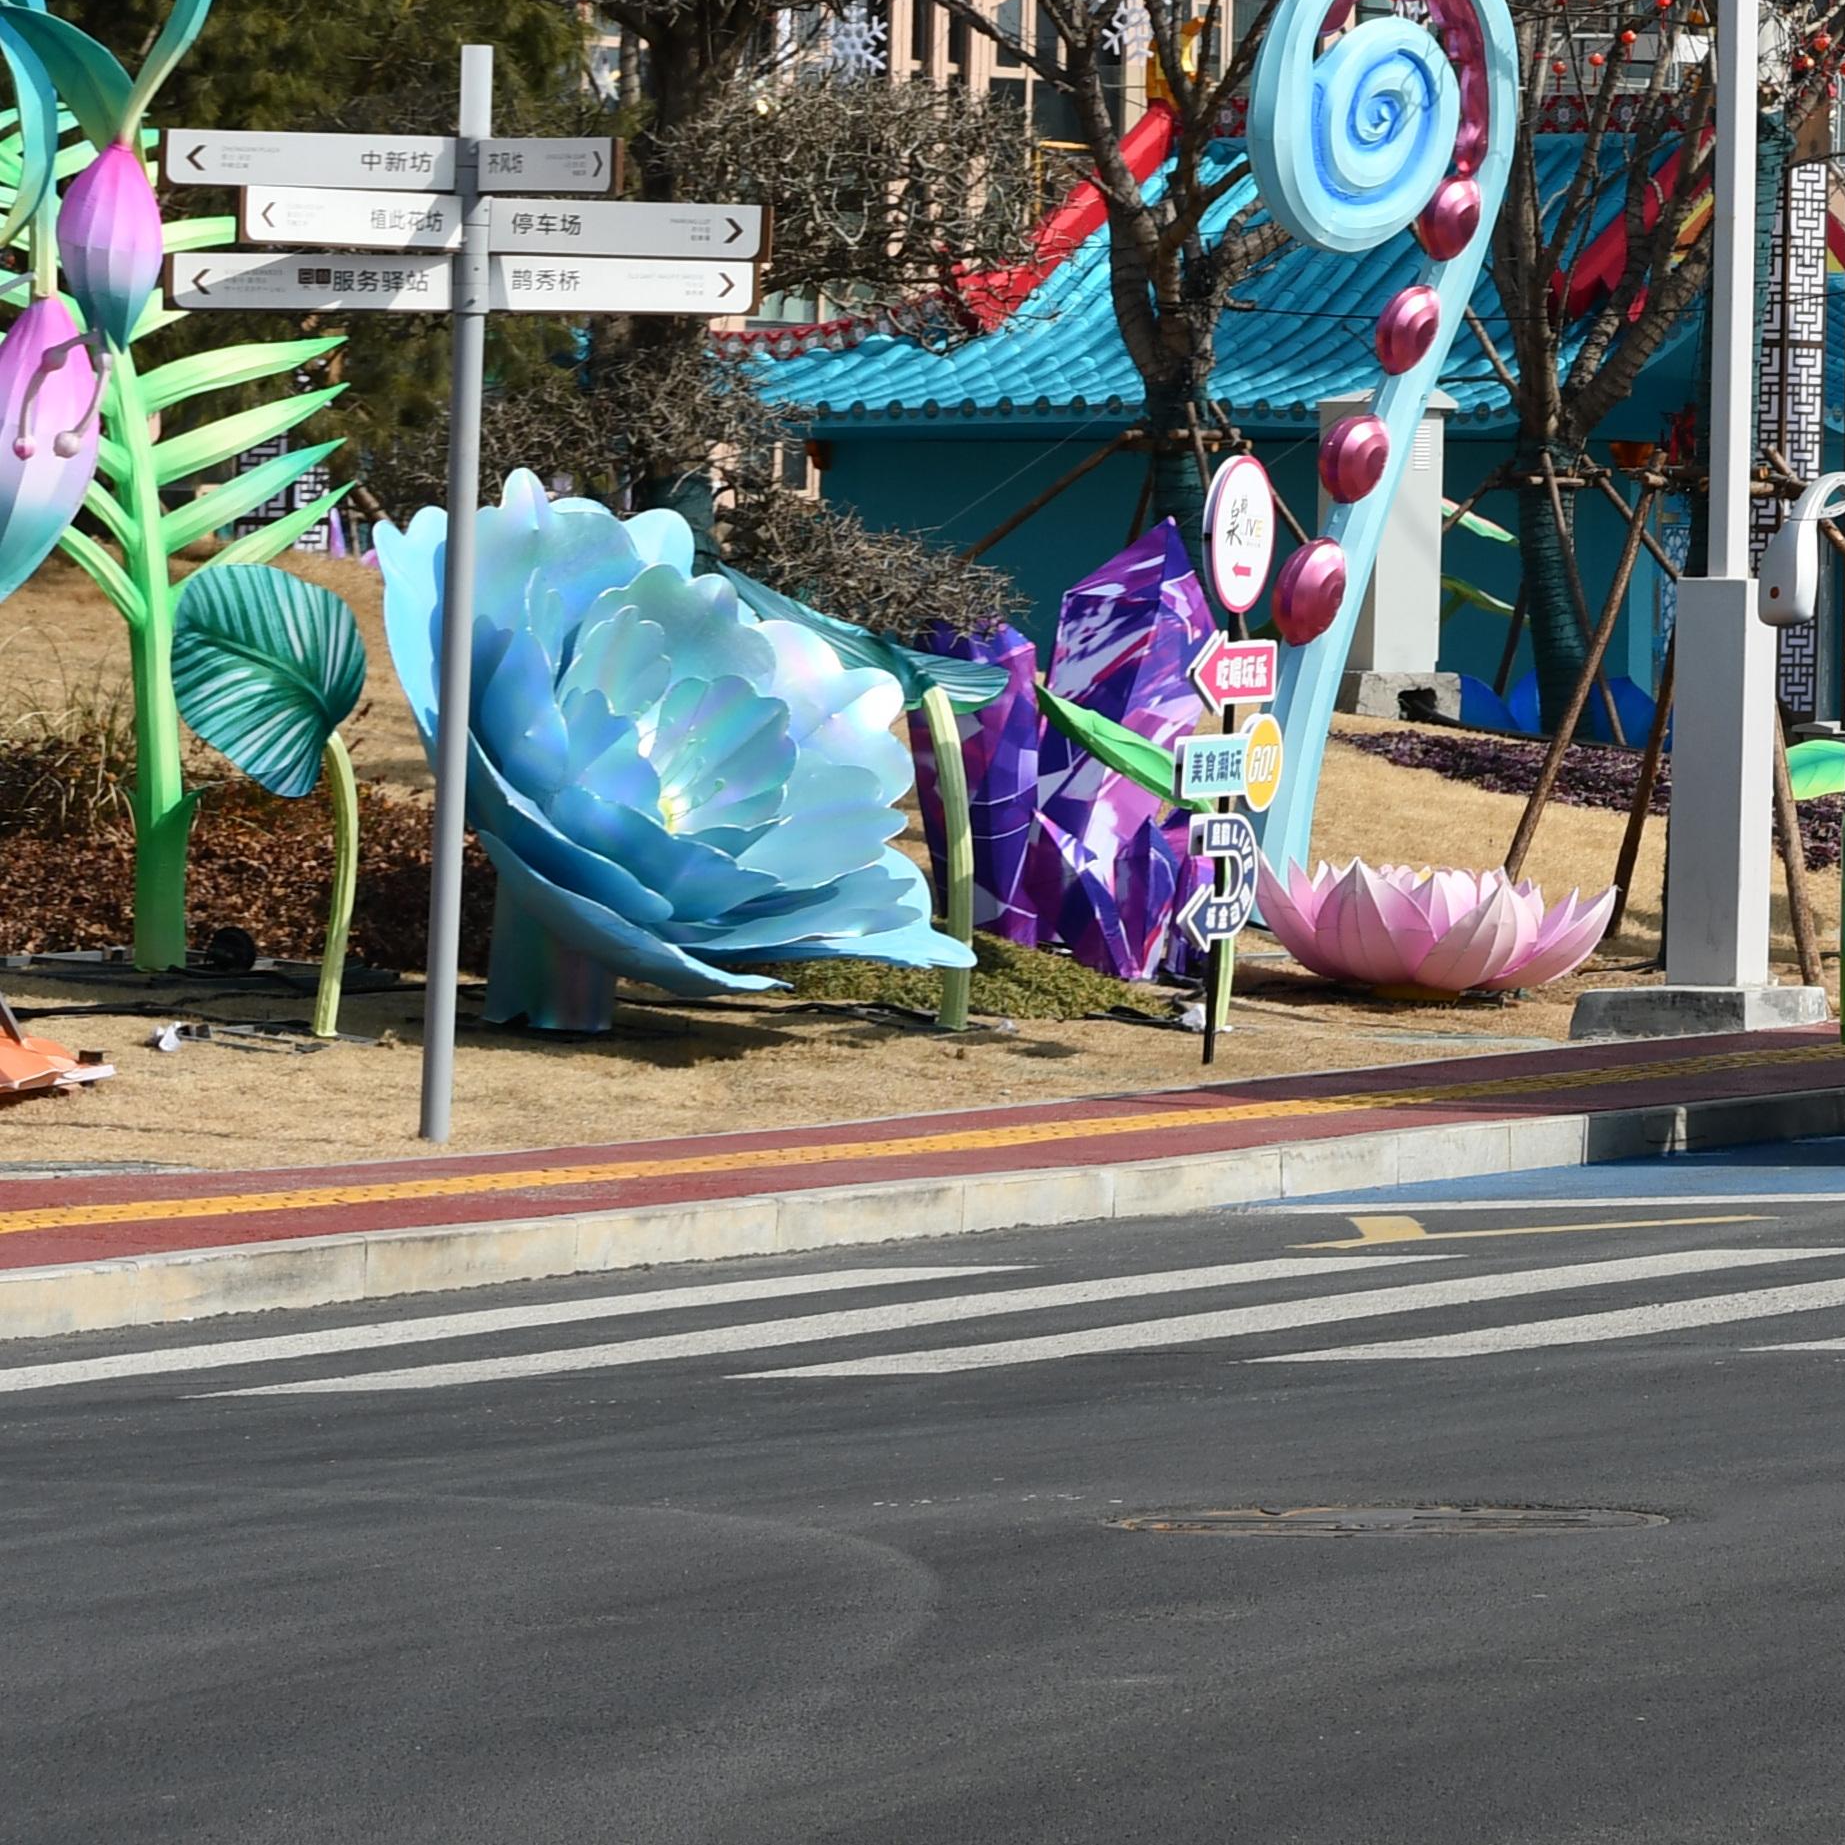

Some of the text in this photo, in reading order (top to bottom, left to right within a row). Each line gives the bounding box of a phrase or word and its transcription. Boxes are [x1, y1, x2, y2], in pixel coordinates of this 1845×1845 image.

[360, 150, 433, 173] 中新坊
[512, 212, 581, 236] 停车场
[333, 269, 429, 293] 服务驿站
[511, 269, 581, 292] 鹊秀桥
[1191, 745, 1279, 784] 美食潮玩 GO!
